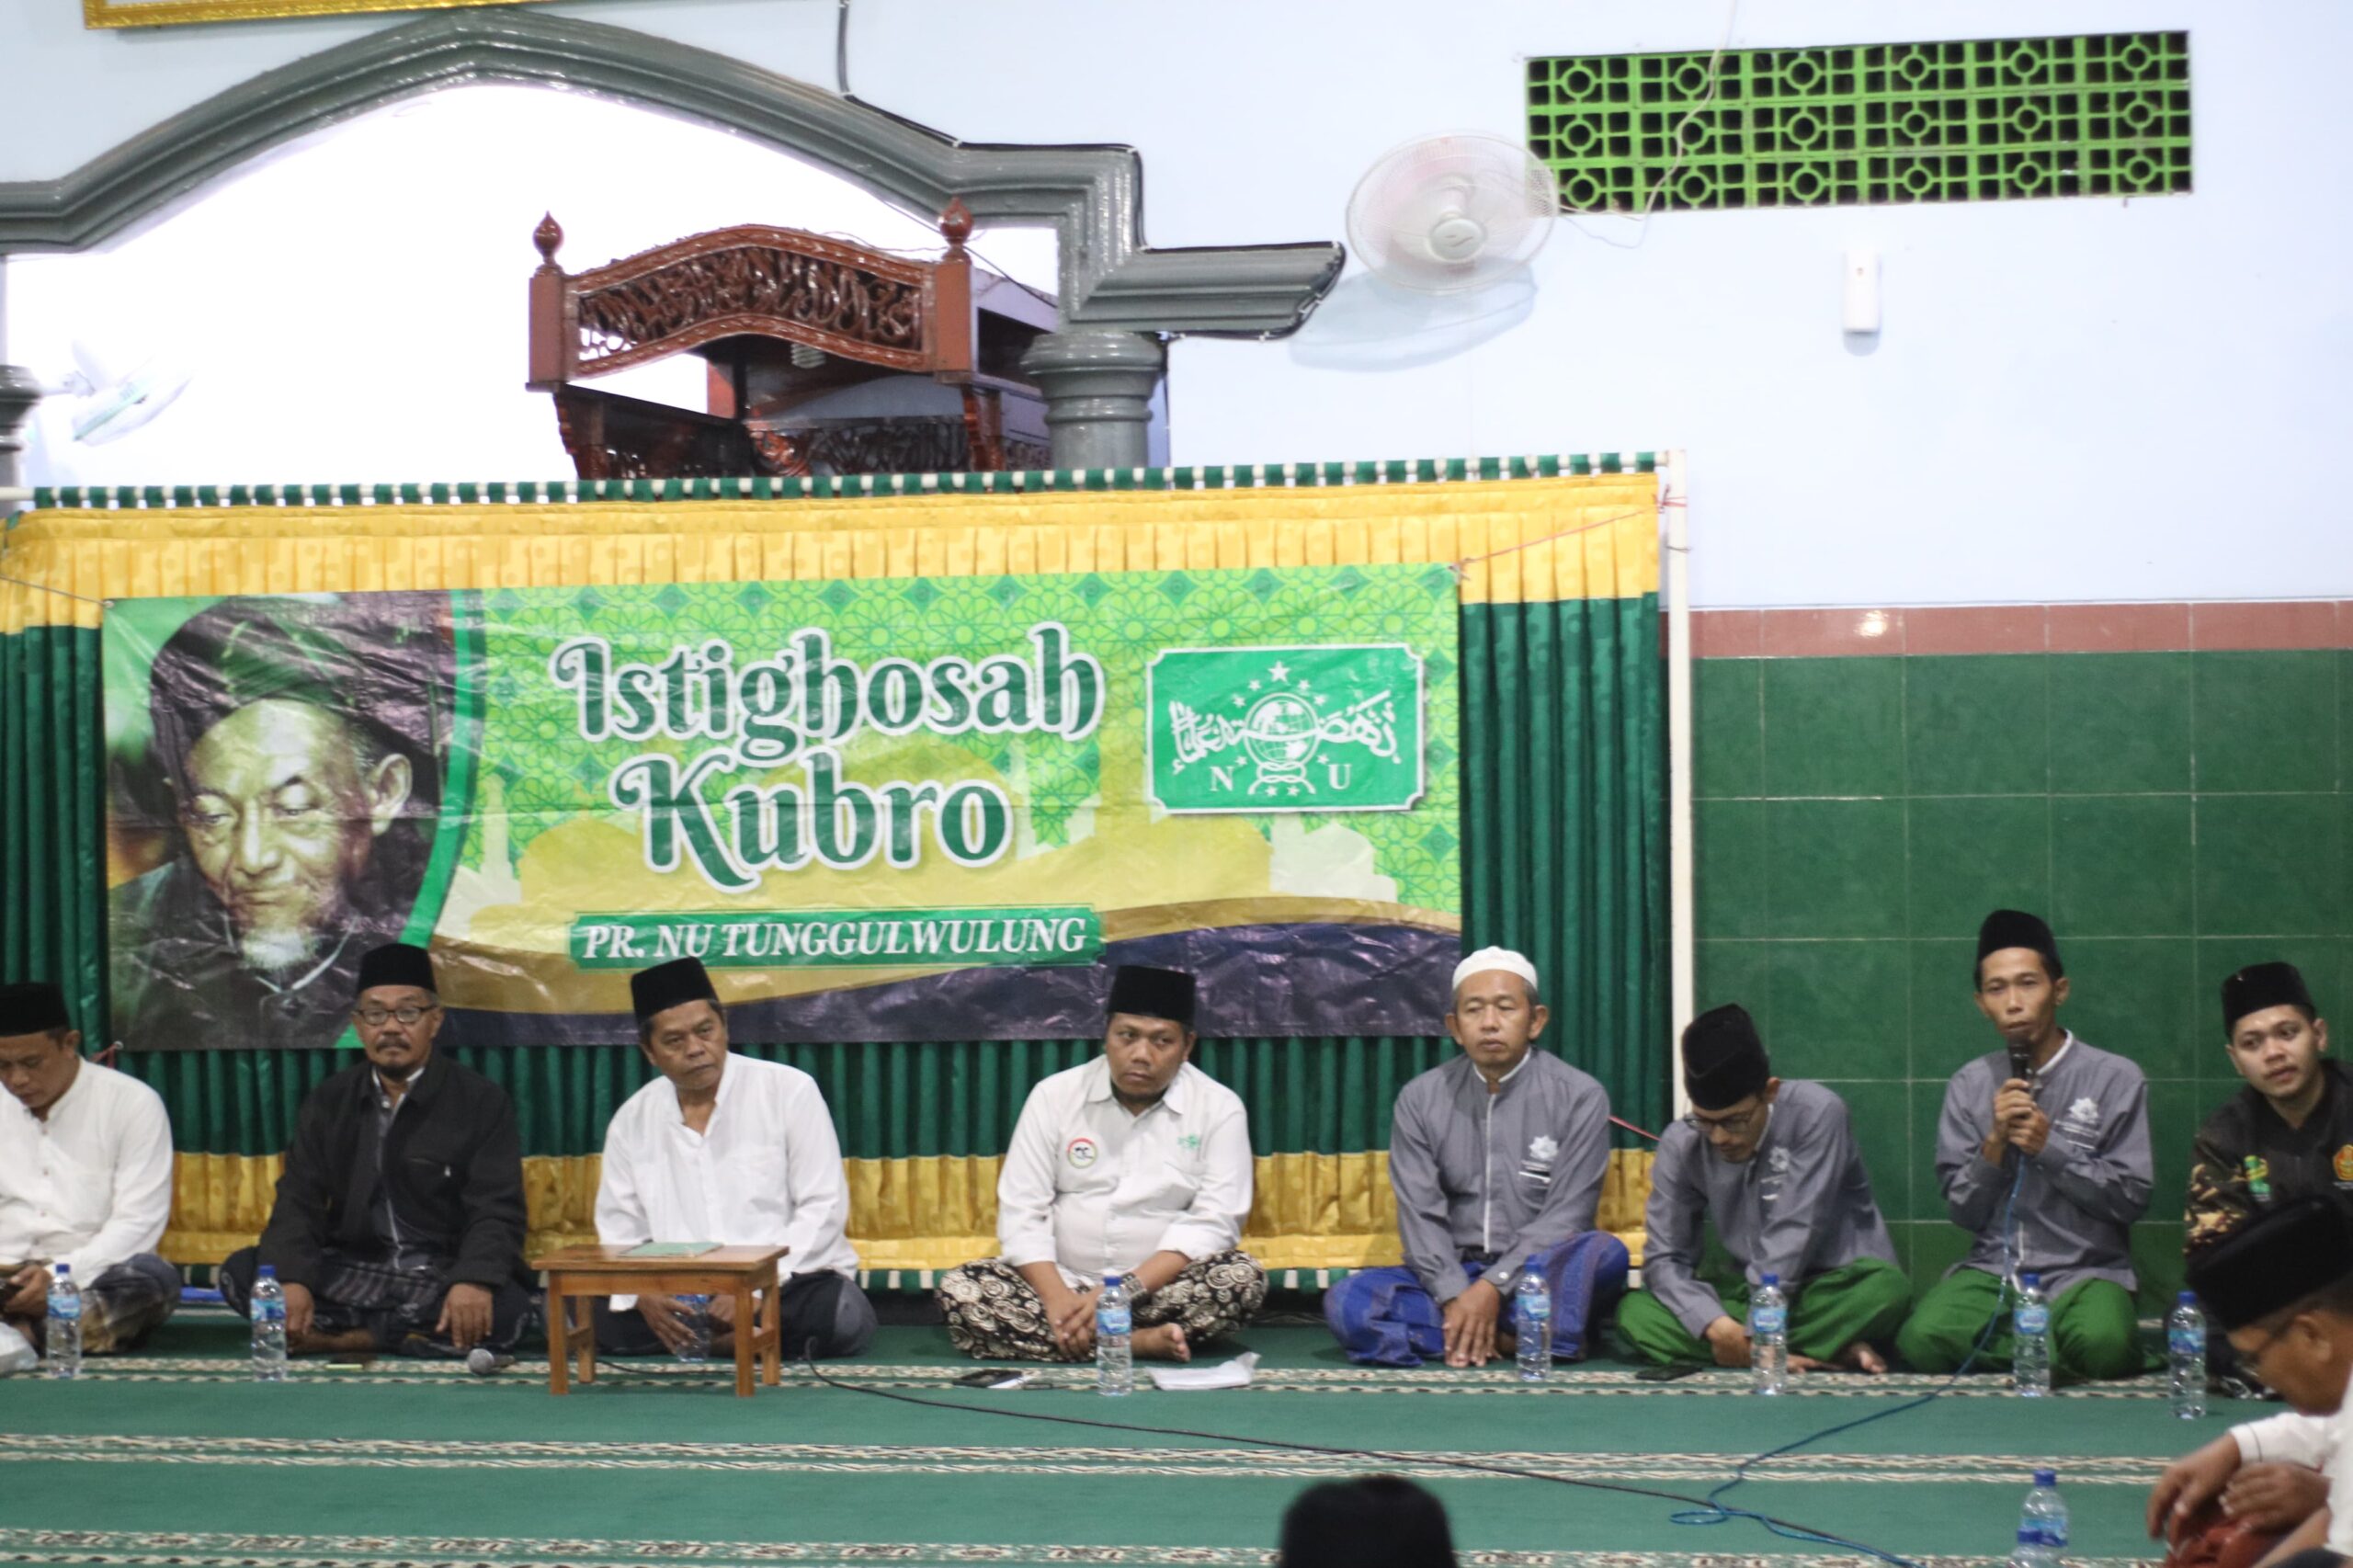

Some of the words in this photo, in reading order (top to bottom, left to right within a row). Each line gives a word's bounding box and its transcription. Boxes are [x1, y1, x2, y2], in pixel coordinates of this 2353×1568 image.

[550, 621, 1105, 767] Istighosah
[608, 746, 1014, 892] Kubro
[1209, 766, 1234, 791] N
[1328, 763, 1352, 790] U
[583, 926, 645, 959] PR.
[655, 925, 713, 958] NU
[721, 917, 1086, 958] TUNGGULWULUNG
